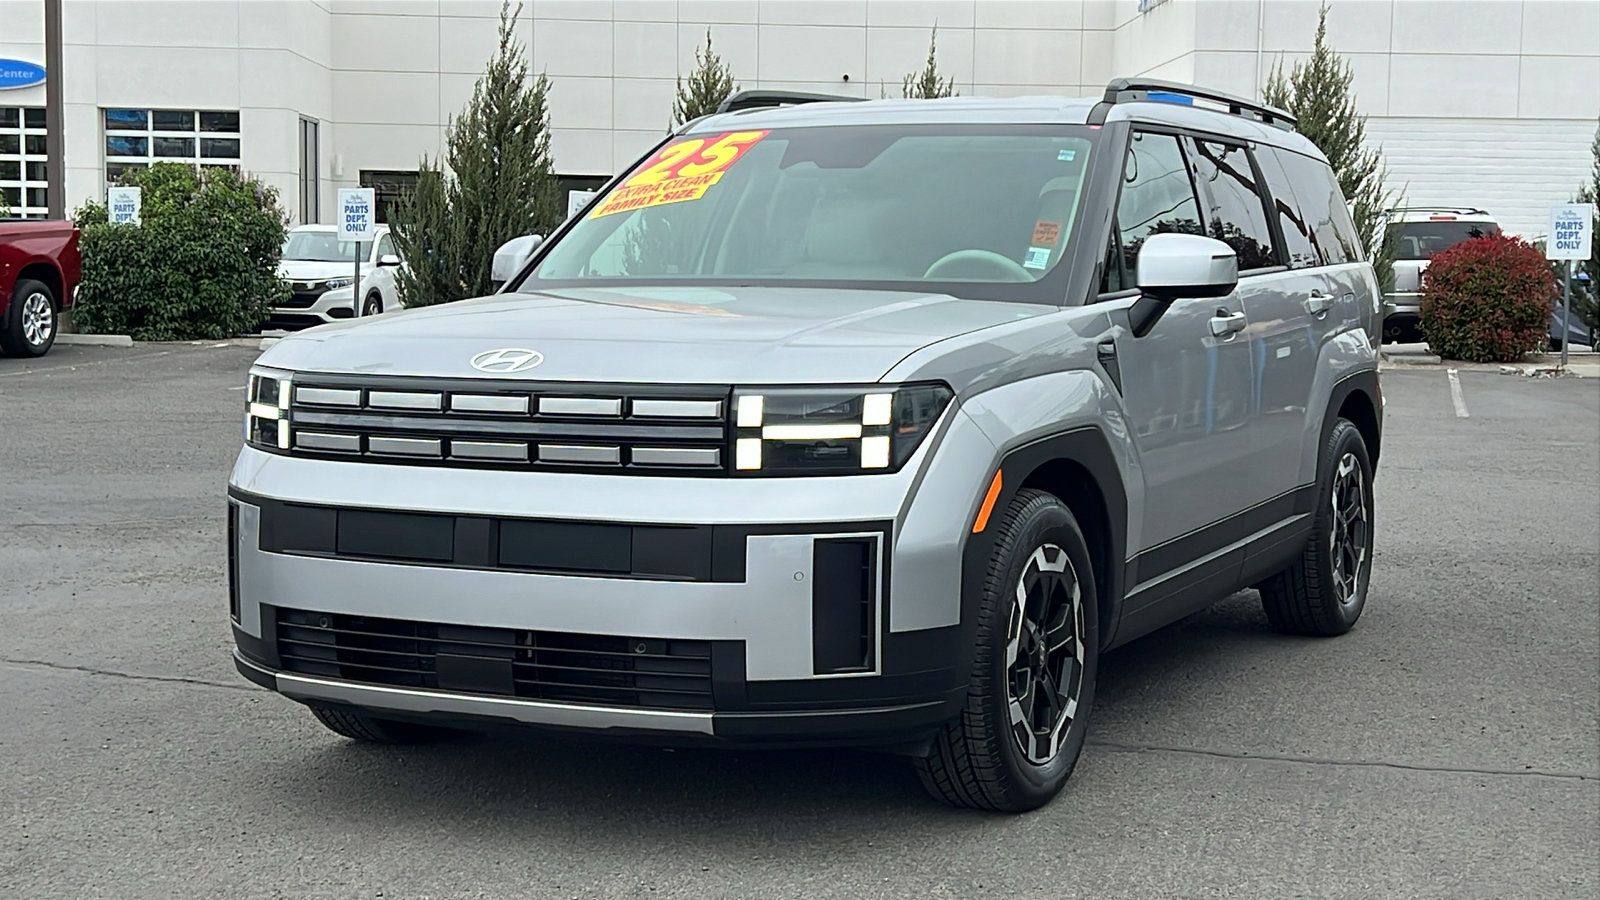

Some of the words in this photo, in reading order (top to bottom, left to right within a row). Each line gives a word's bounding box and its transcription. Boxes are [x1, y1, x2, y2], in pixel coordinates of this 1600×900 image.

[624, 131, 763, 187] 25
[612, 183, 663, 202] EXTRA
[663, 174, 716, 192] CLEAN
[599, 194, 661, 215] FAMILY
[659, 187, 700, 203] SIZE
[114, 204, 135, 212] PARTS
[344, 205, 369, 213] PARTS
[346, 214, 367, 223] DEPT.
[345, 223, 367, 232] ONLY
[1555, 221, 1584, 230] PARTS
[1556, 231, 1581, 240] DEPT.
[1556, 240, 1581, 250] ONLY
